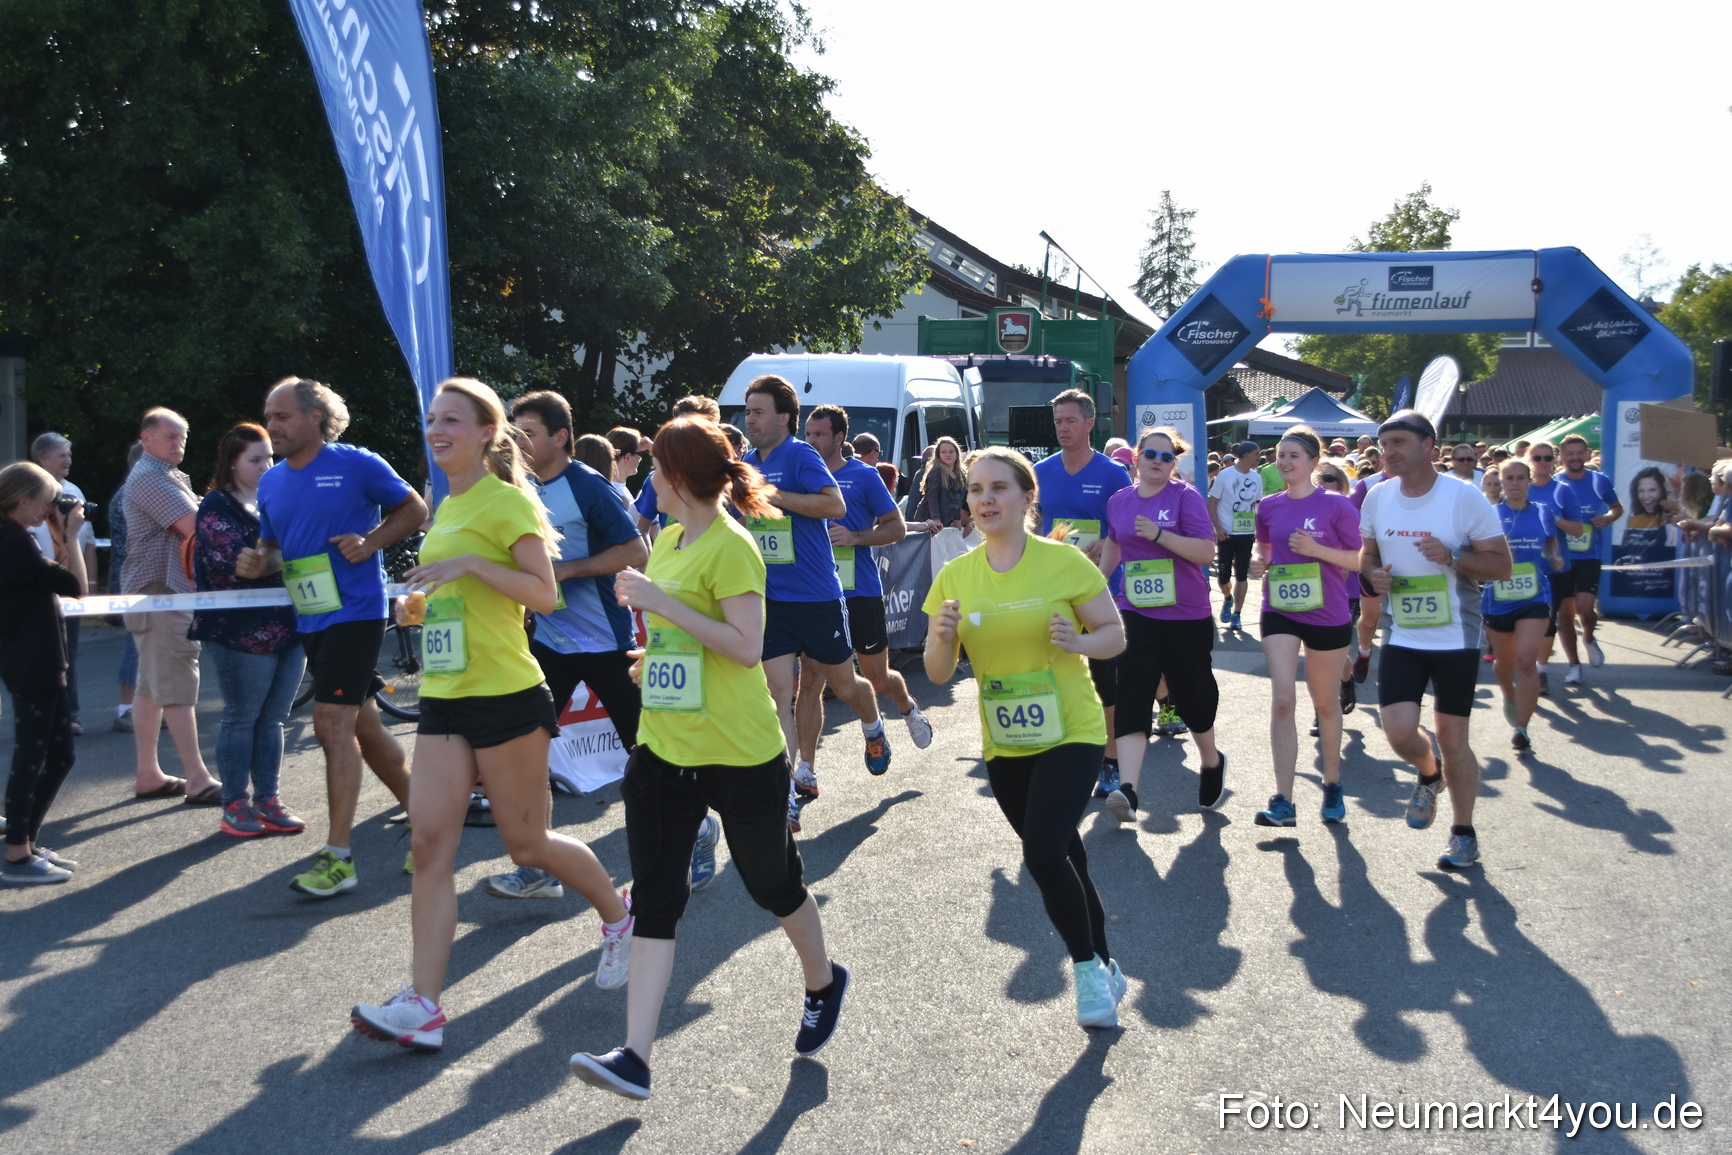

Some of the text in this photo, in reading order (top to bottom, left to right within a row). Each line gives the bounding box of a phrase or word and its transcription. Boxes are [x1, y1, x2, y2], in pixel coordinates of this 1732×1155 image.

[1397, 274, 1431, 282] Fischer
[1372, 291, 1472, 310] firmenlauf
[1187, 328, 1239, 339] Fischer
[1157, 509, 1170, 521] K
[1303, 518, 1317, 530] K
[760, 535, 778, 551] 16
[297, 580, 318, 600] 11
[1134, 578, 1165, 595] 688
[1278, 583, 1311, 600] 689
[1401, 596, 1438, 614] 575
[426, 628, 452, 655] 661
[647, 661, 687, 690] 660
[995, 703, 1045, 729] 649
